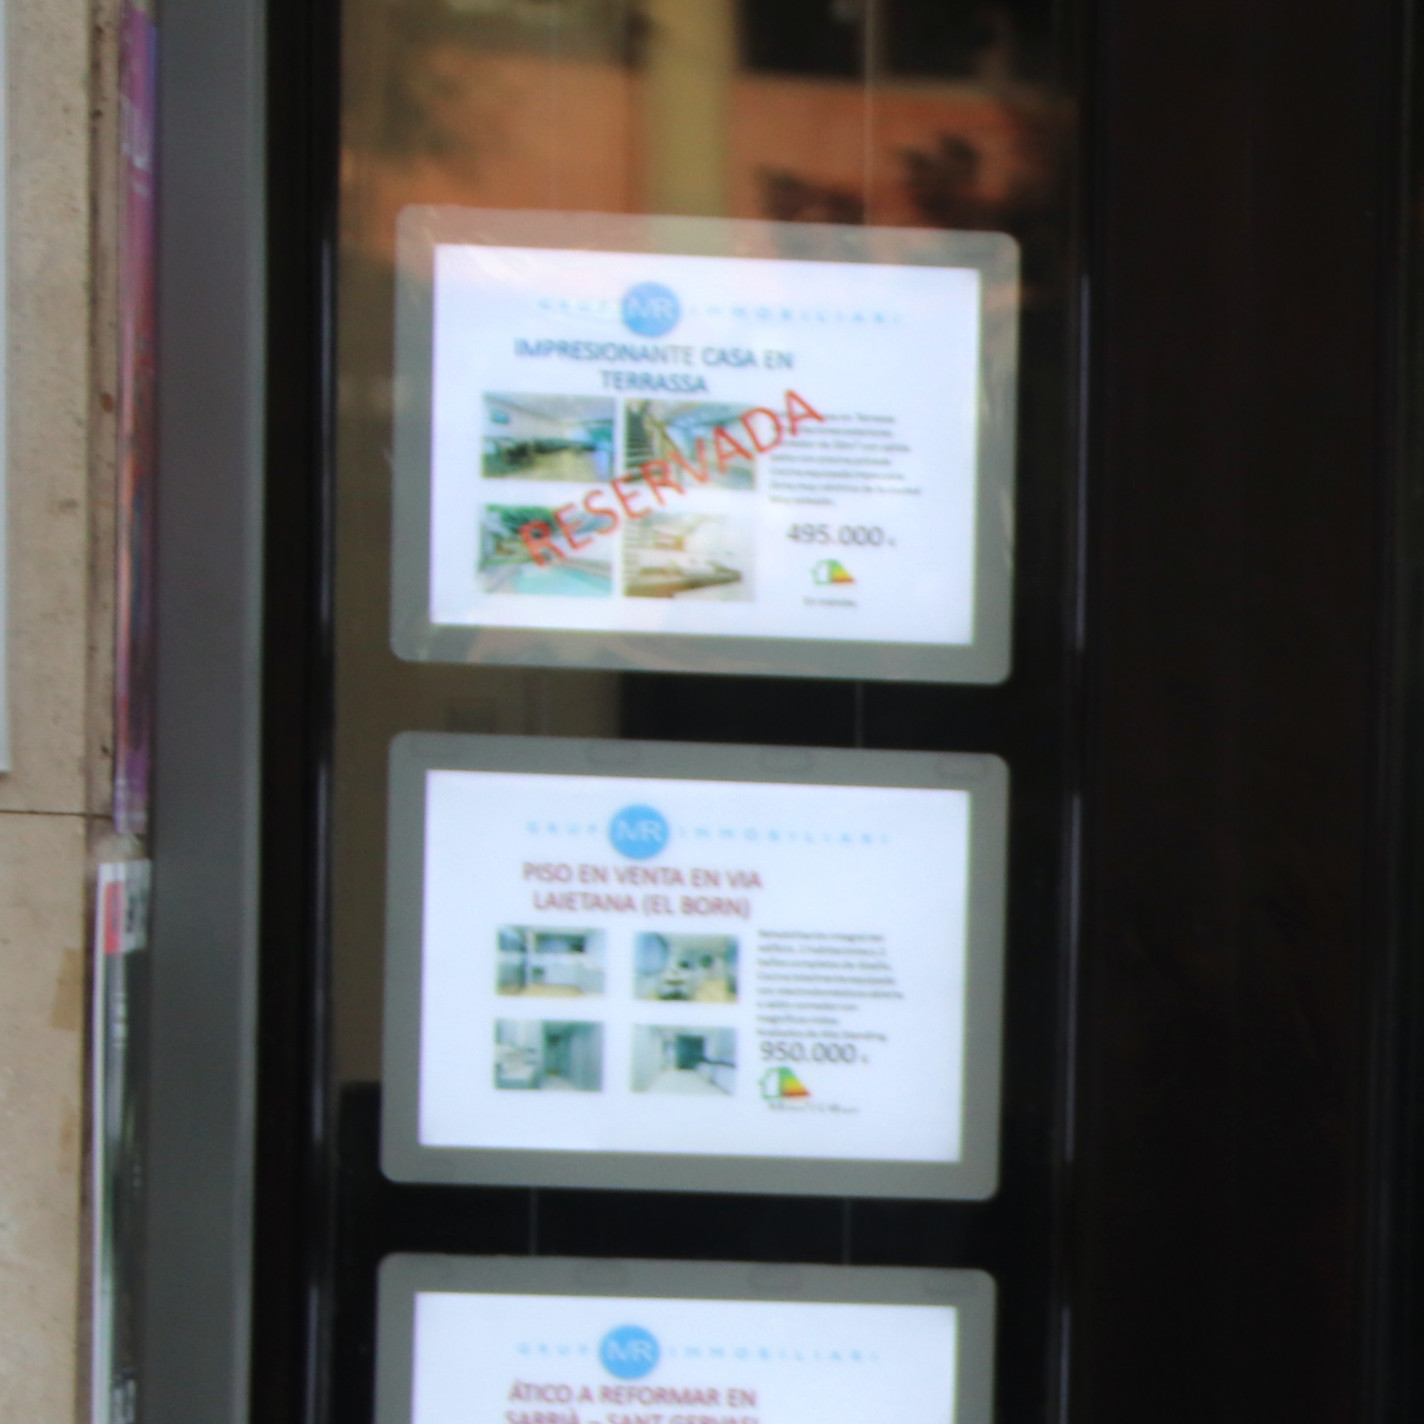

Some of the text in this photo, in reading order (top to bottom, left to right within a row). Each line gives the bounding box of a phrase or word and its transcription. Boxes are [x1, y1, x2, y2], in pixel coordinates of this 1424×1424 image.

[514, 338, 794, 370] IMPRESIONANTE CASA EN
[600, 370, 708, 394] TERRASSA
[518, 388, 826, 567] RESERVADA
[786, 523, 885, 547] 495.000
[522, 862, 573, 885] PISO
[578, 864, 609, 885] EN
[614, 866, 683, 888] VENTA
[690, 868, 720, 889] EN
[533, 890, 751, 920] LAIETANA (EL BORN)
[759, 1041, 858, 1064] 950.000
[508, 1379, 758, 1408] ÁTICO A REFORMAR EN
